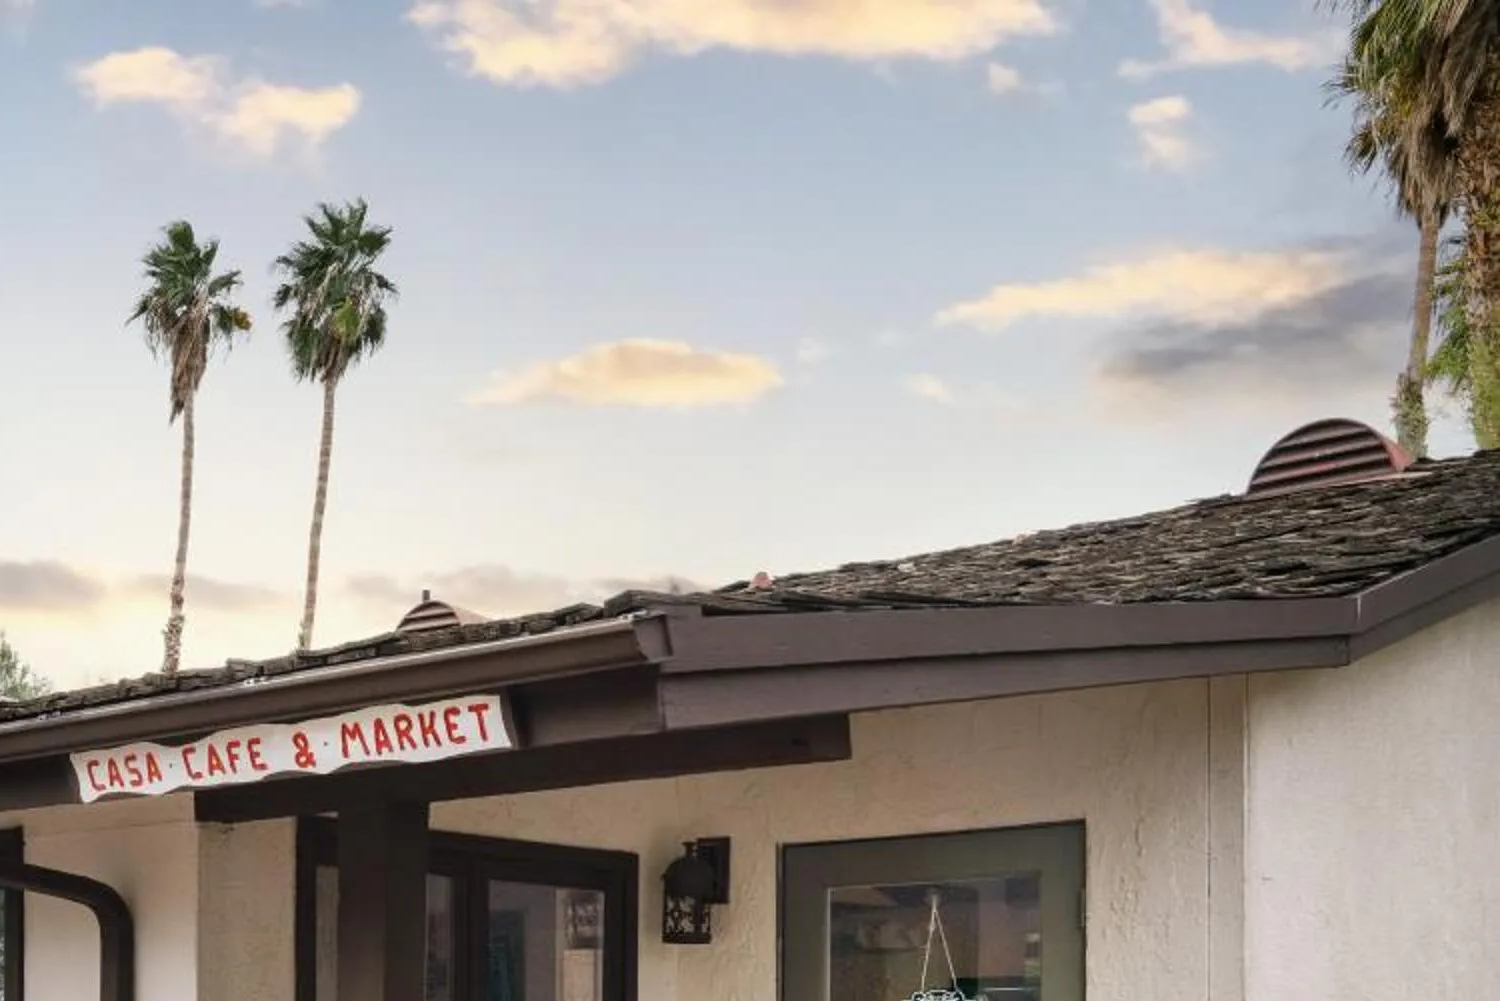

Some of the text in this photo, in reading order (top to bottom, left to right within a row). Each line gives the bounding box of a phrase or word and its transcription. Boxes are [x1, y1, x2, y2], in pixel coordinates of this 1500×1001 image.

[86, 703, 490, 792] CASA CAFE & MARKET
